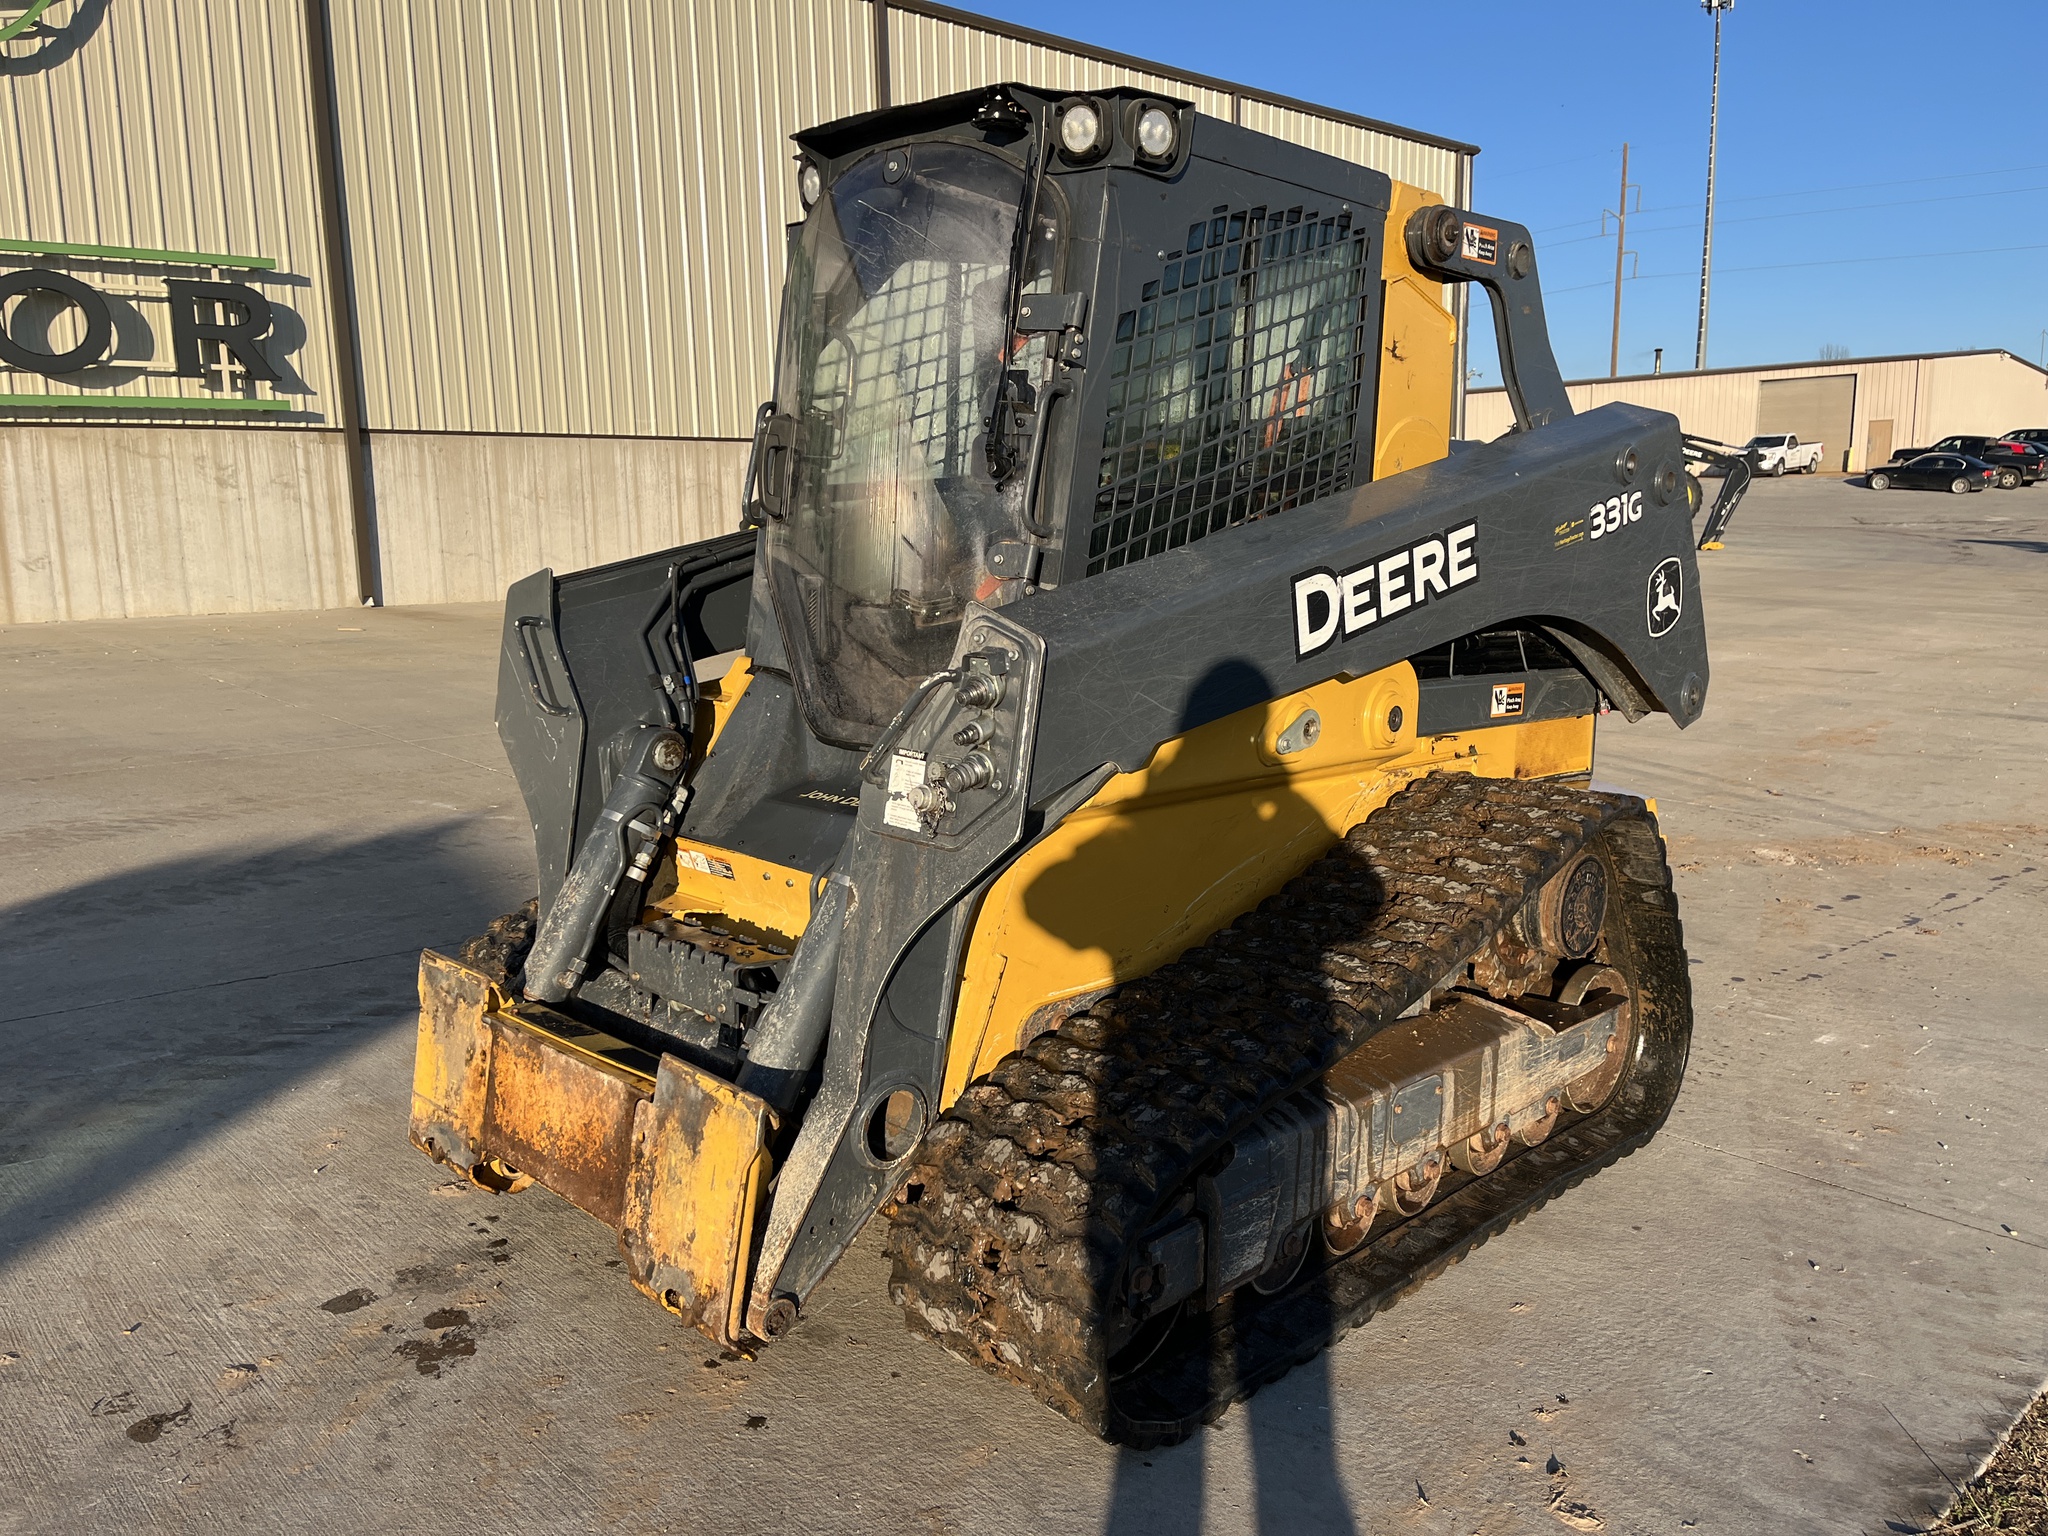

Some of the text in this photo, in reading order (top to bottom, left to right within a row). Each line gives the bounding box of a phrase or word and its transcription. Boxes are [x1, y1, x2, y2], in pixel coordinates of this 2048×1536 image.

[1590, 491, 1642, 540] 331G
[1295, 523, 1477, 655] DEERE
[799, 790, 845, 803] JOHN
